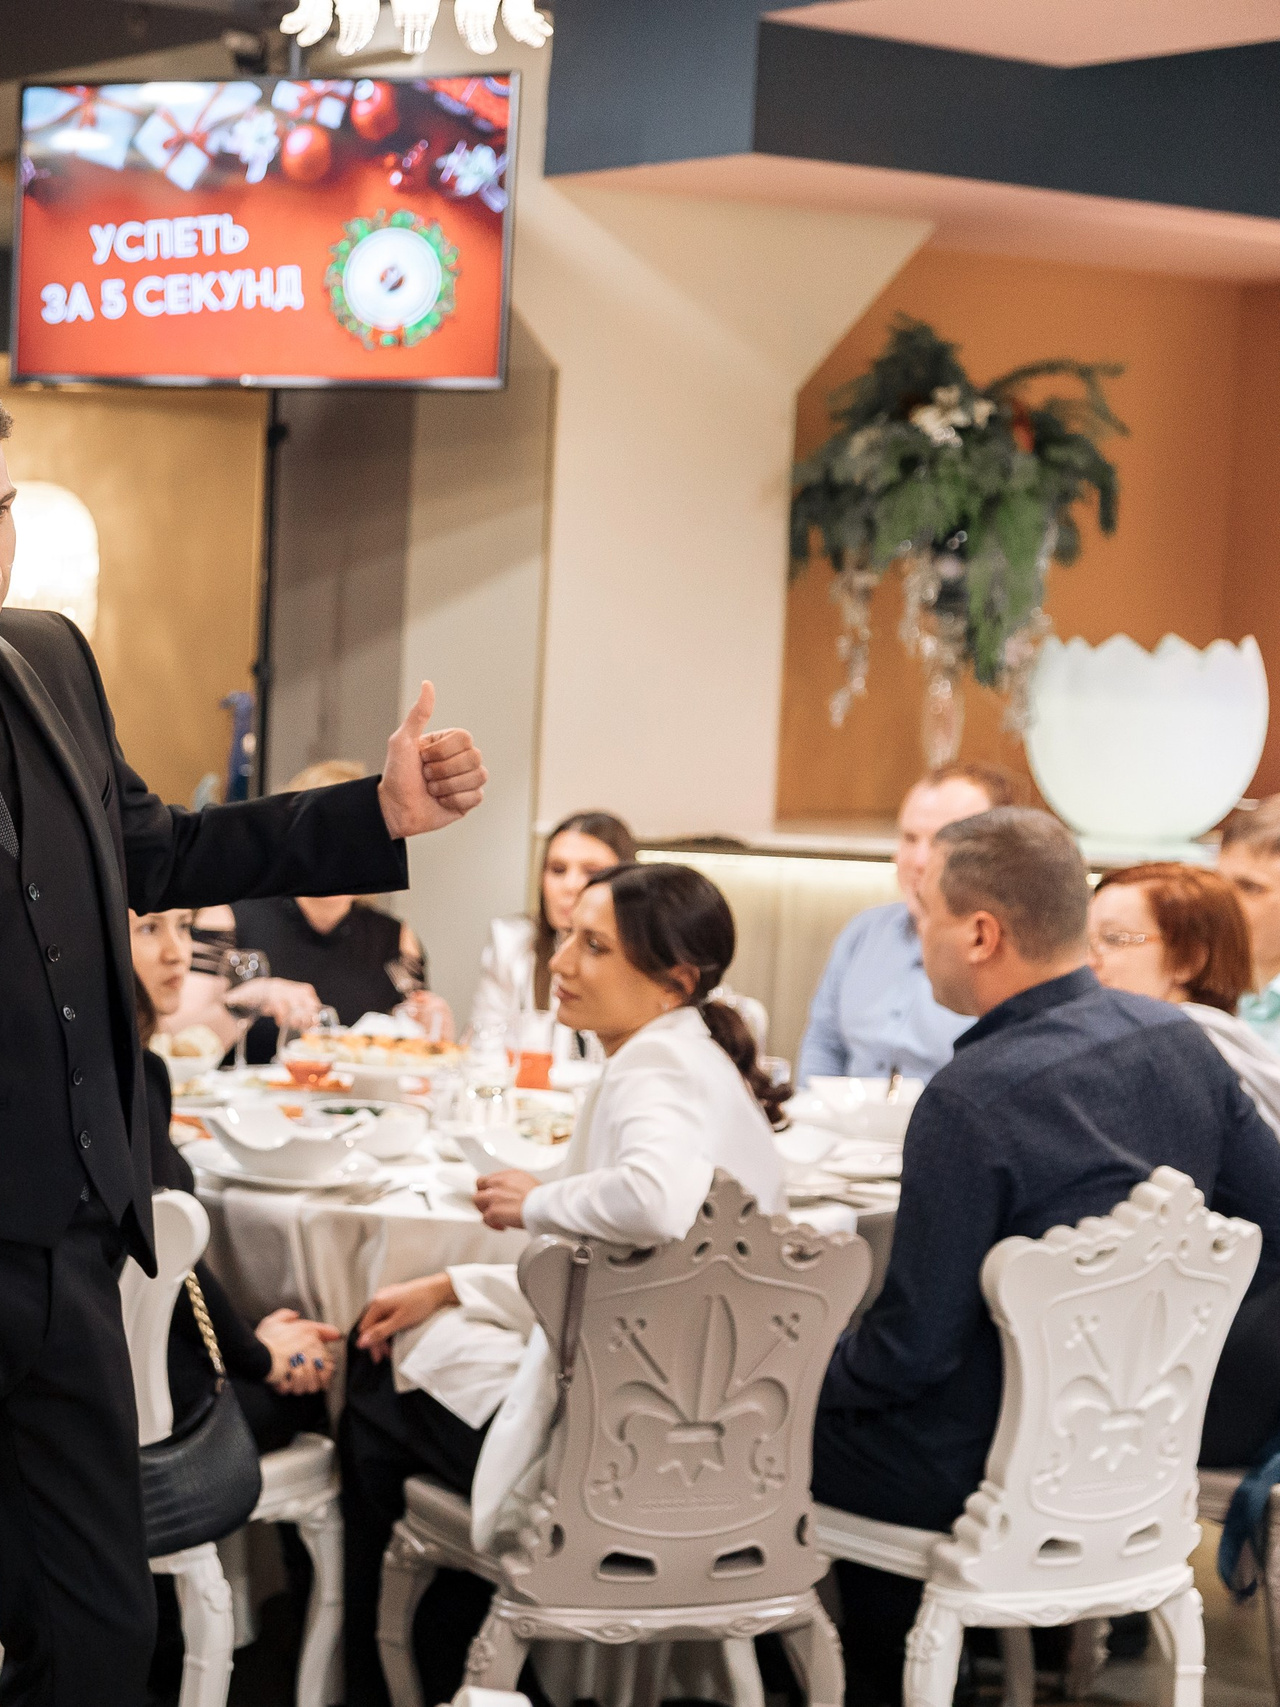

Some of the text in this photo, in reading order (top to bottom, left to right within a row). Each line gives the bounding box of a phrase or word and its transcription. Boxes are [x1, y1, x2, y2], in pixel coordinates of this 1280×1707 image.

[90, 213, 249, 265] УСПЕТЬ
[40, 265, 304, 324] ЗА 5 СЕКУНД
